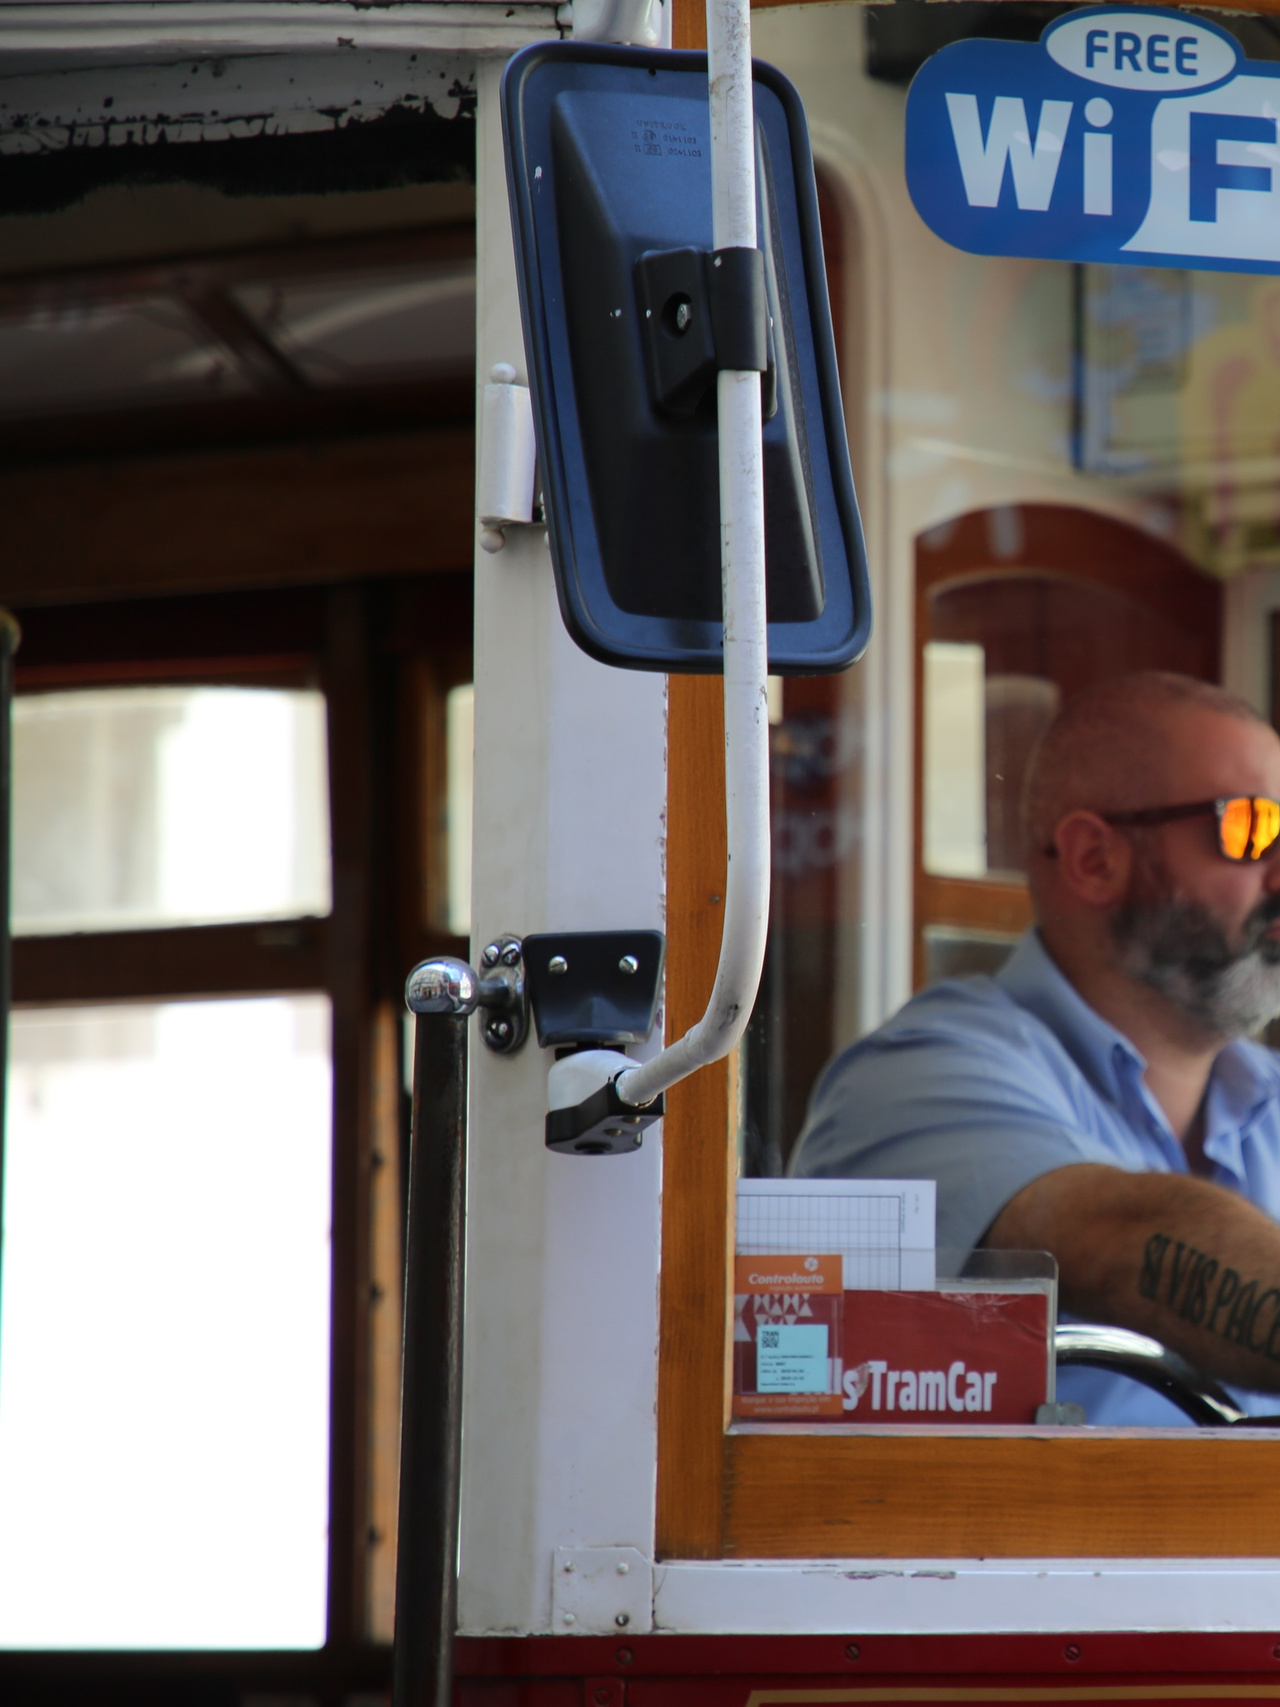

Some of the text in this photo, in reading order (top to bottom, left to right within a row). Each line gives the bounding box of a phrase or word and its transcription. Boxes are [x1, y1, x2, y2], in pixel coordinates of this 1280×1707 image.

[1085, 29, 1199, 77] FREE
[1166, 1241, 1220, 1326] VIS
[868, 1360, 998, 1412] TramCar
